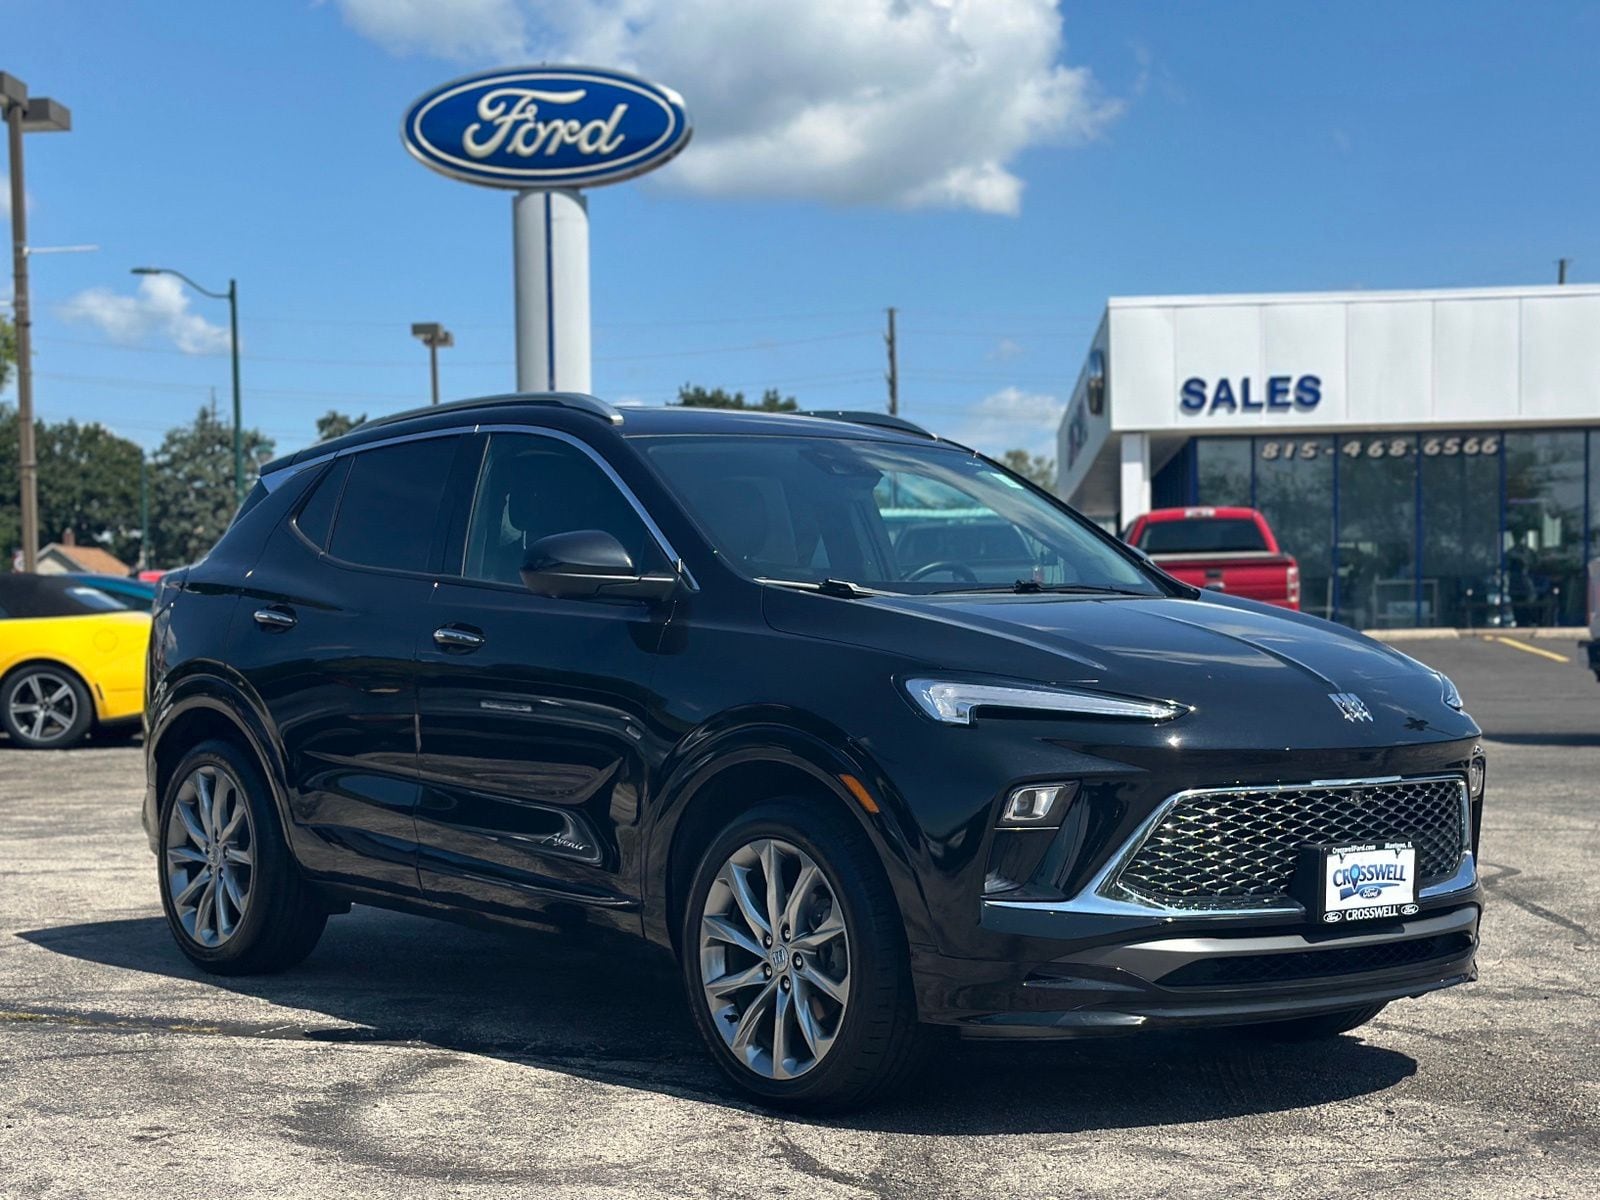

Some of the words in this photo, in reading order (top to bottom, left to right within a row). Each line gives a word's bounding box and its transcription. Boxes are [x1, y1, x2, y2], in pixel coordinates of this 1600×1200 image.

[462, 87, 629, 158] Ford
[1180, 375, 1322, 415] SALES
[540, 832, 591, 850] Avenir
[1333, 864, 1406, 888] CROSSWELL
[1346, 905, 1398, 921] CROSSWELL
